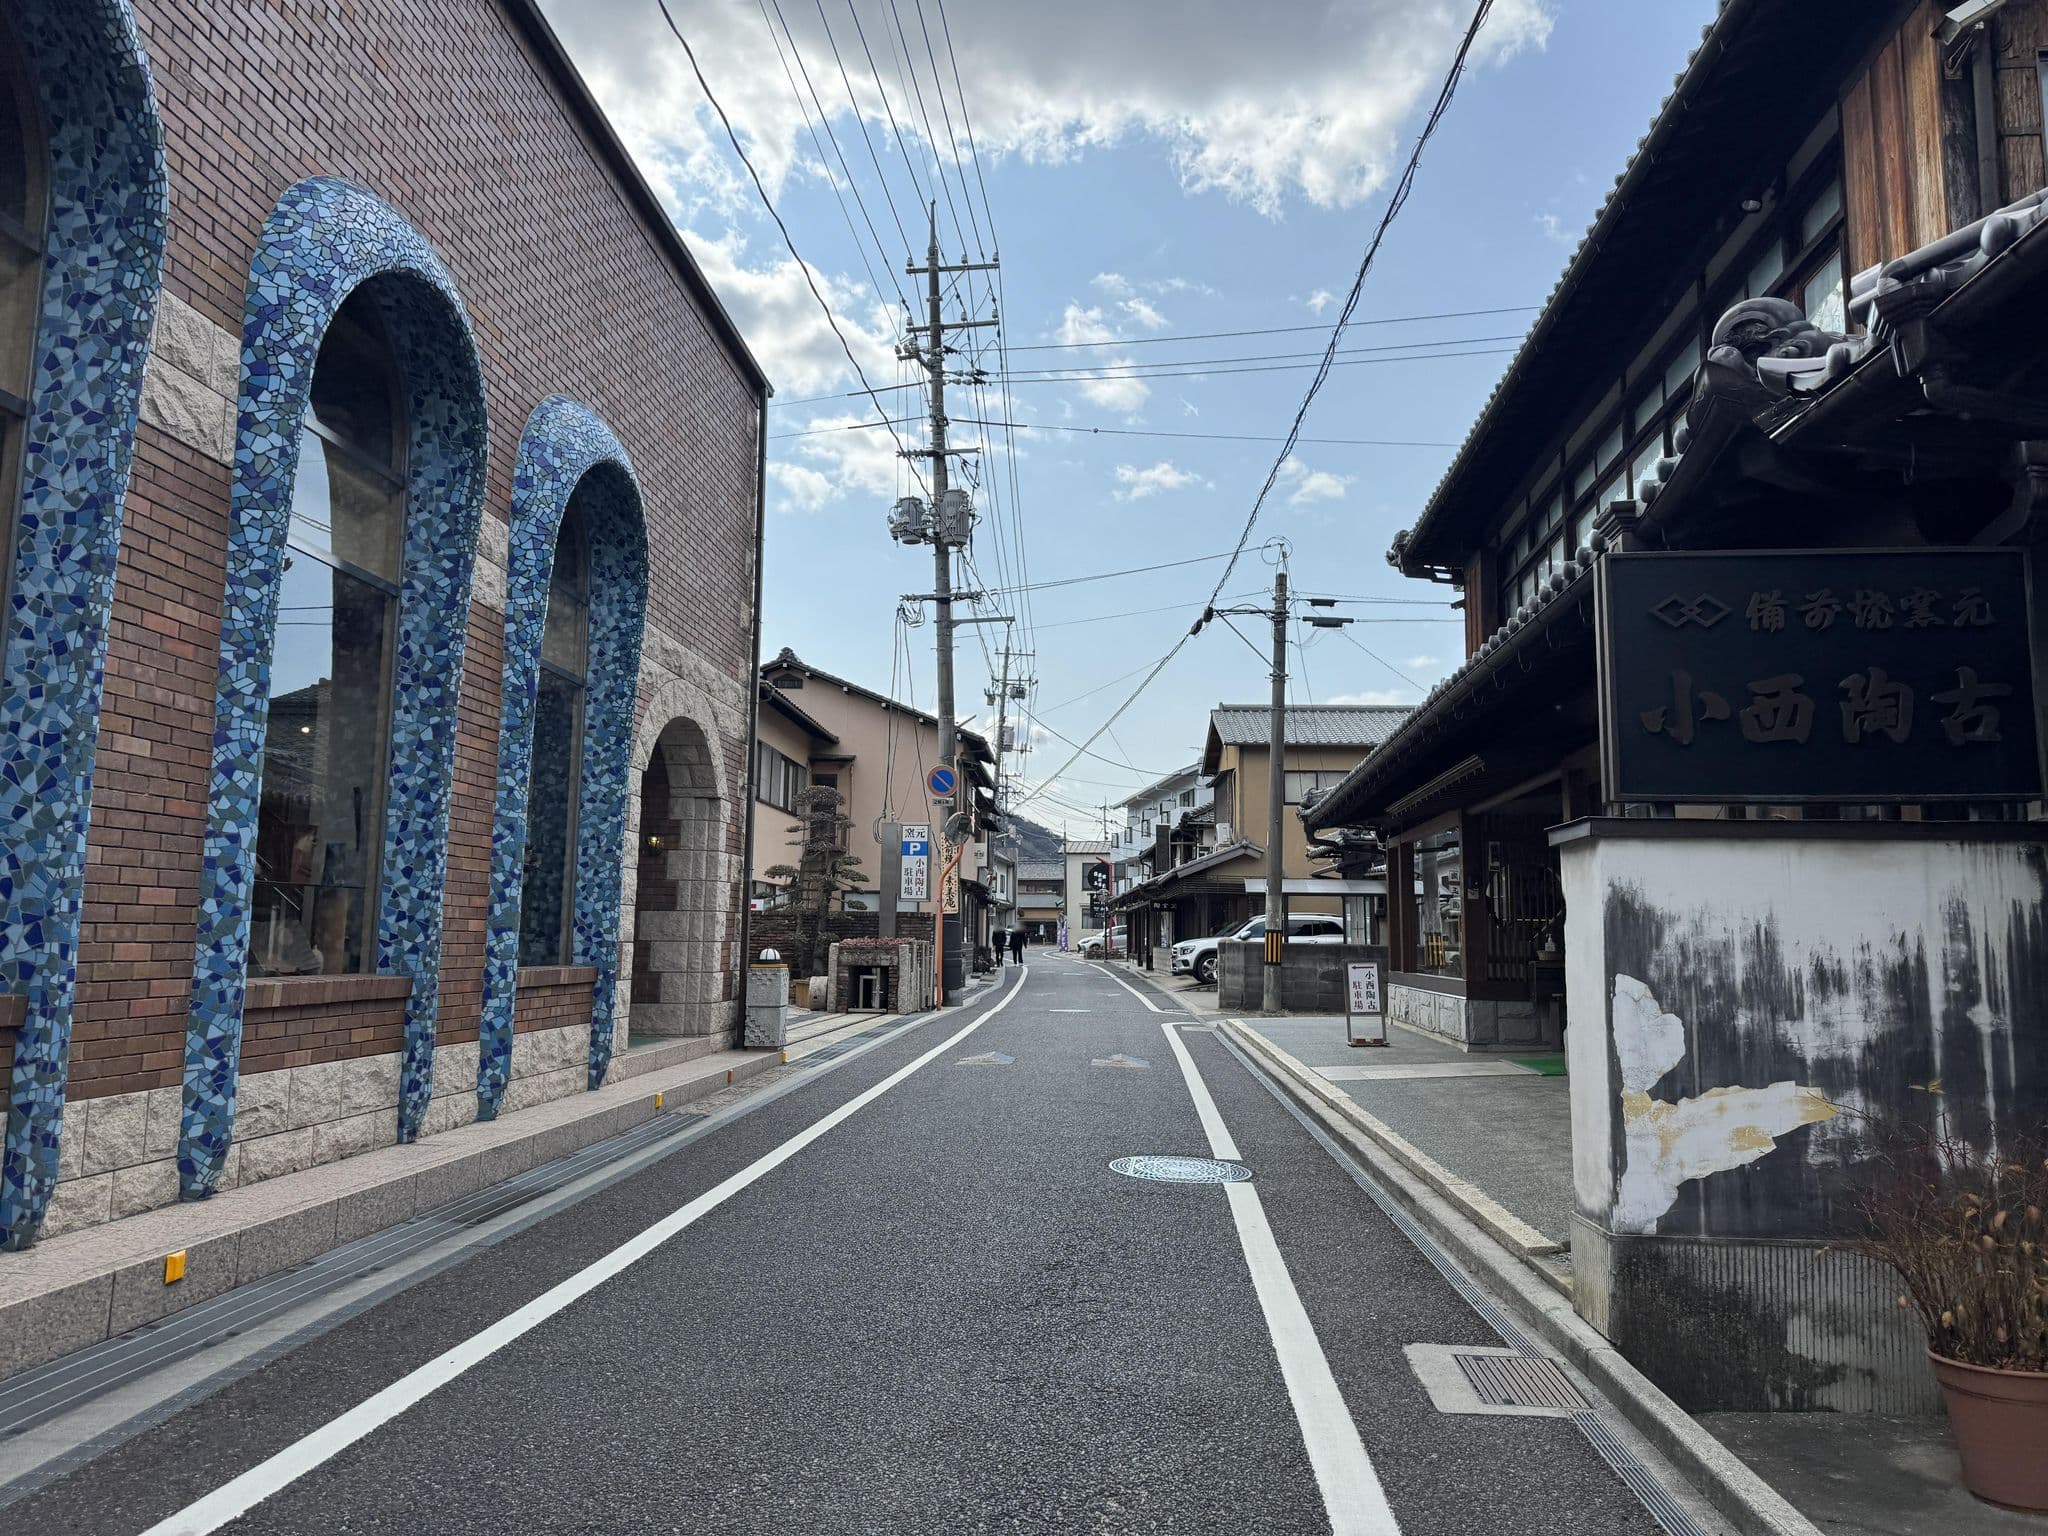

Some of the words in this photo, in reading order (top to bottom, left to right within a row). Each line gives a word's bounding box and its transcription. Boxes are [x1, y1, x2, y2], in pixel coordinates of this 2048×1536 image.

[1640, 666, 2014, 746] 小西陶古
[909, 843, 920, 855] P
[904, 867, 914, 896] 駐車場
[915, 858, 924, 896] 小西陶古
[1353, 981, 1363, 1010] 駐車場
[1365, 970, 1376, 1010] 小西陶古
